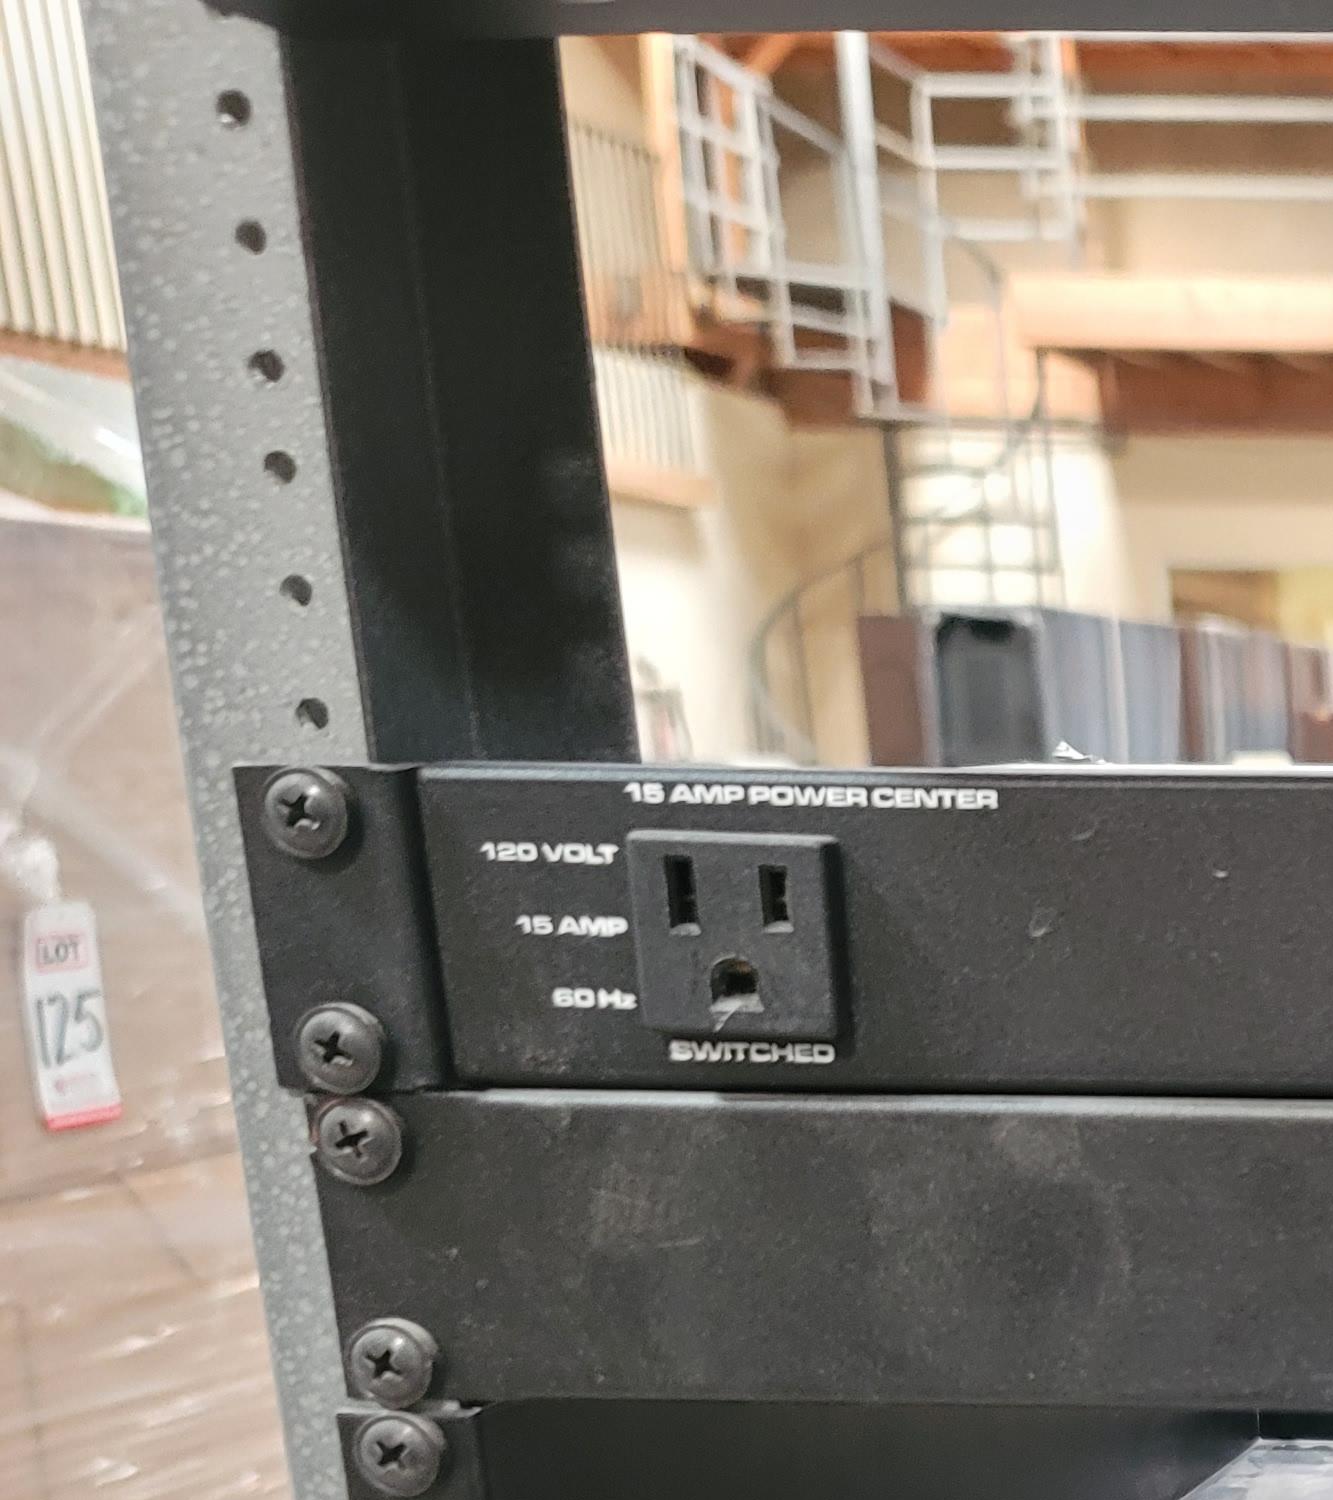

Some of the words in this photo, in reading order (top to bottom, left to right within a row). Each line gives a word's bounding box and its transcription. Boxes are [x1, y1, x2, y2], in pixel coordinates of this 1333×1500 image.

[623, 782, 665, 804] 15
[668, 783, 745, 805] AMP
[749, 785, 868, 808] POWER
[871, 787, 999, 809] CENTER
[480, 841, 538, 862] 120
[541, 842, 619, 864] VOLT
[515, 915, 554, 935] 15
[555, 915, 629, 937] AMP
[39, 941, 80, 965] LOT
[552, 987, 596, 1009] 60
[597, 988, 638, 1010] Hz
[35, 989, 104, 1070] 125
[668, 1039, 836, 1064] SWITCHED
